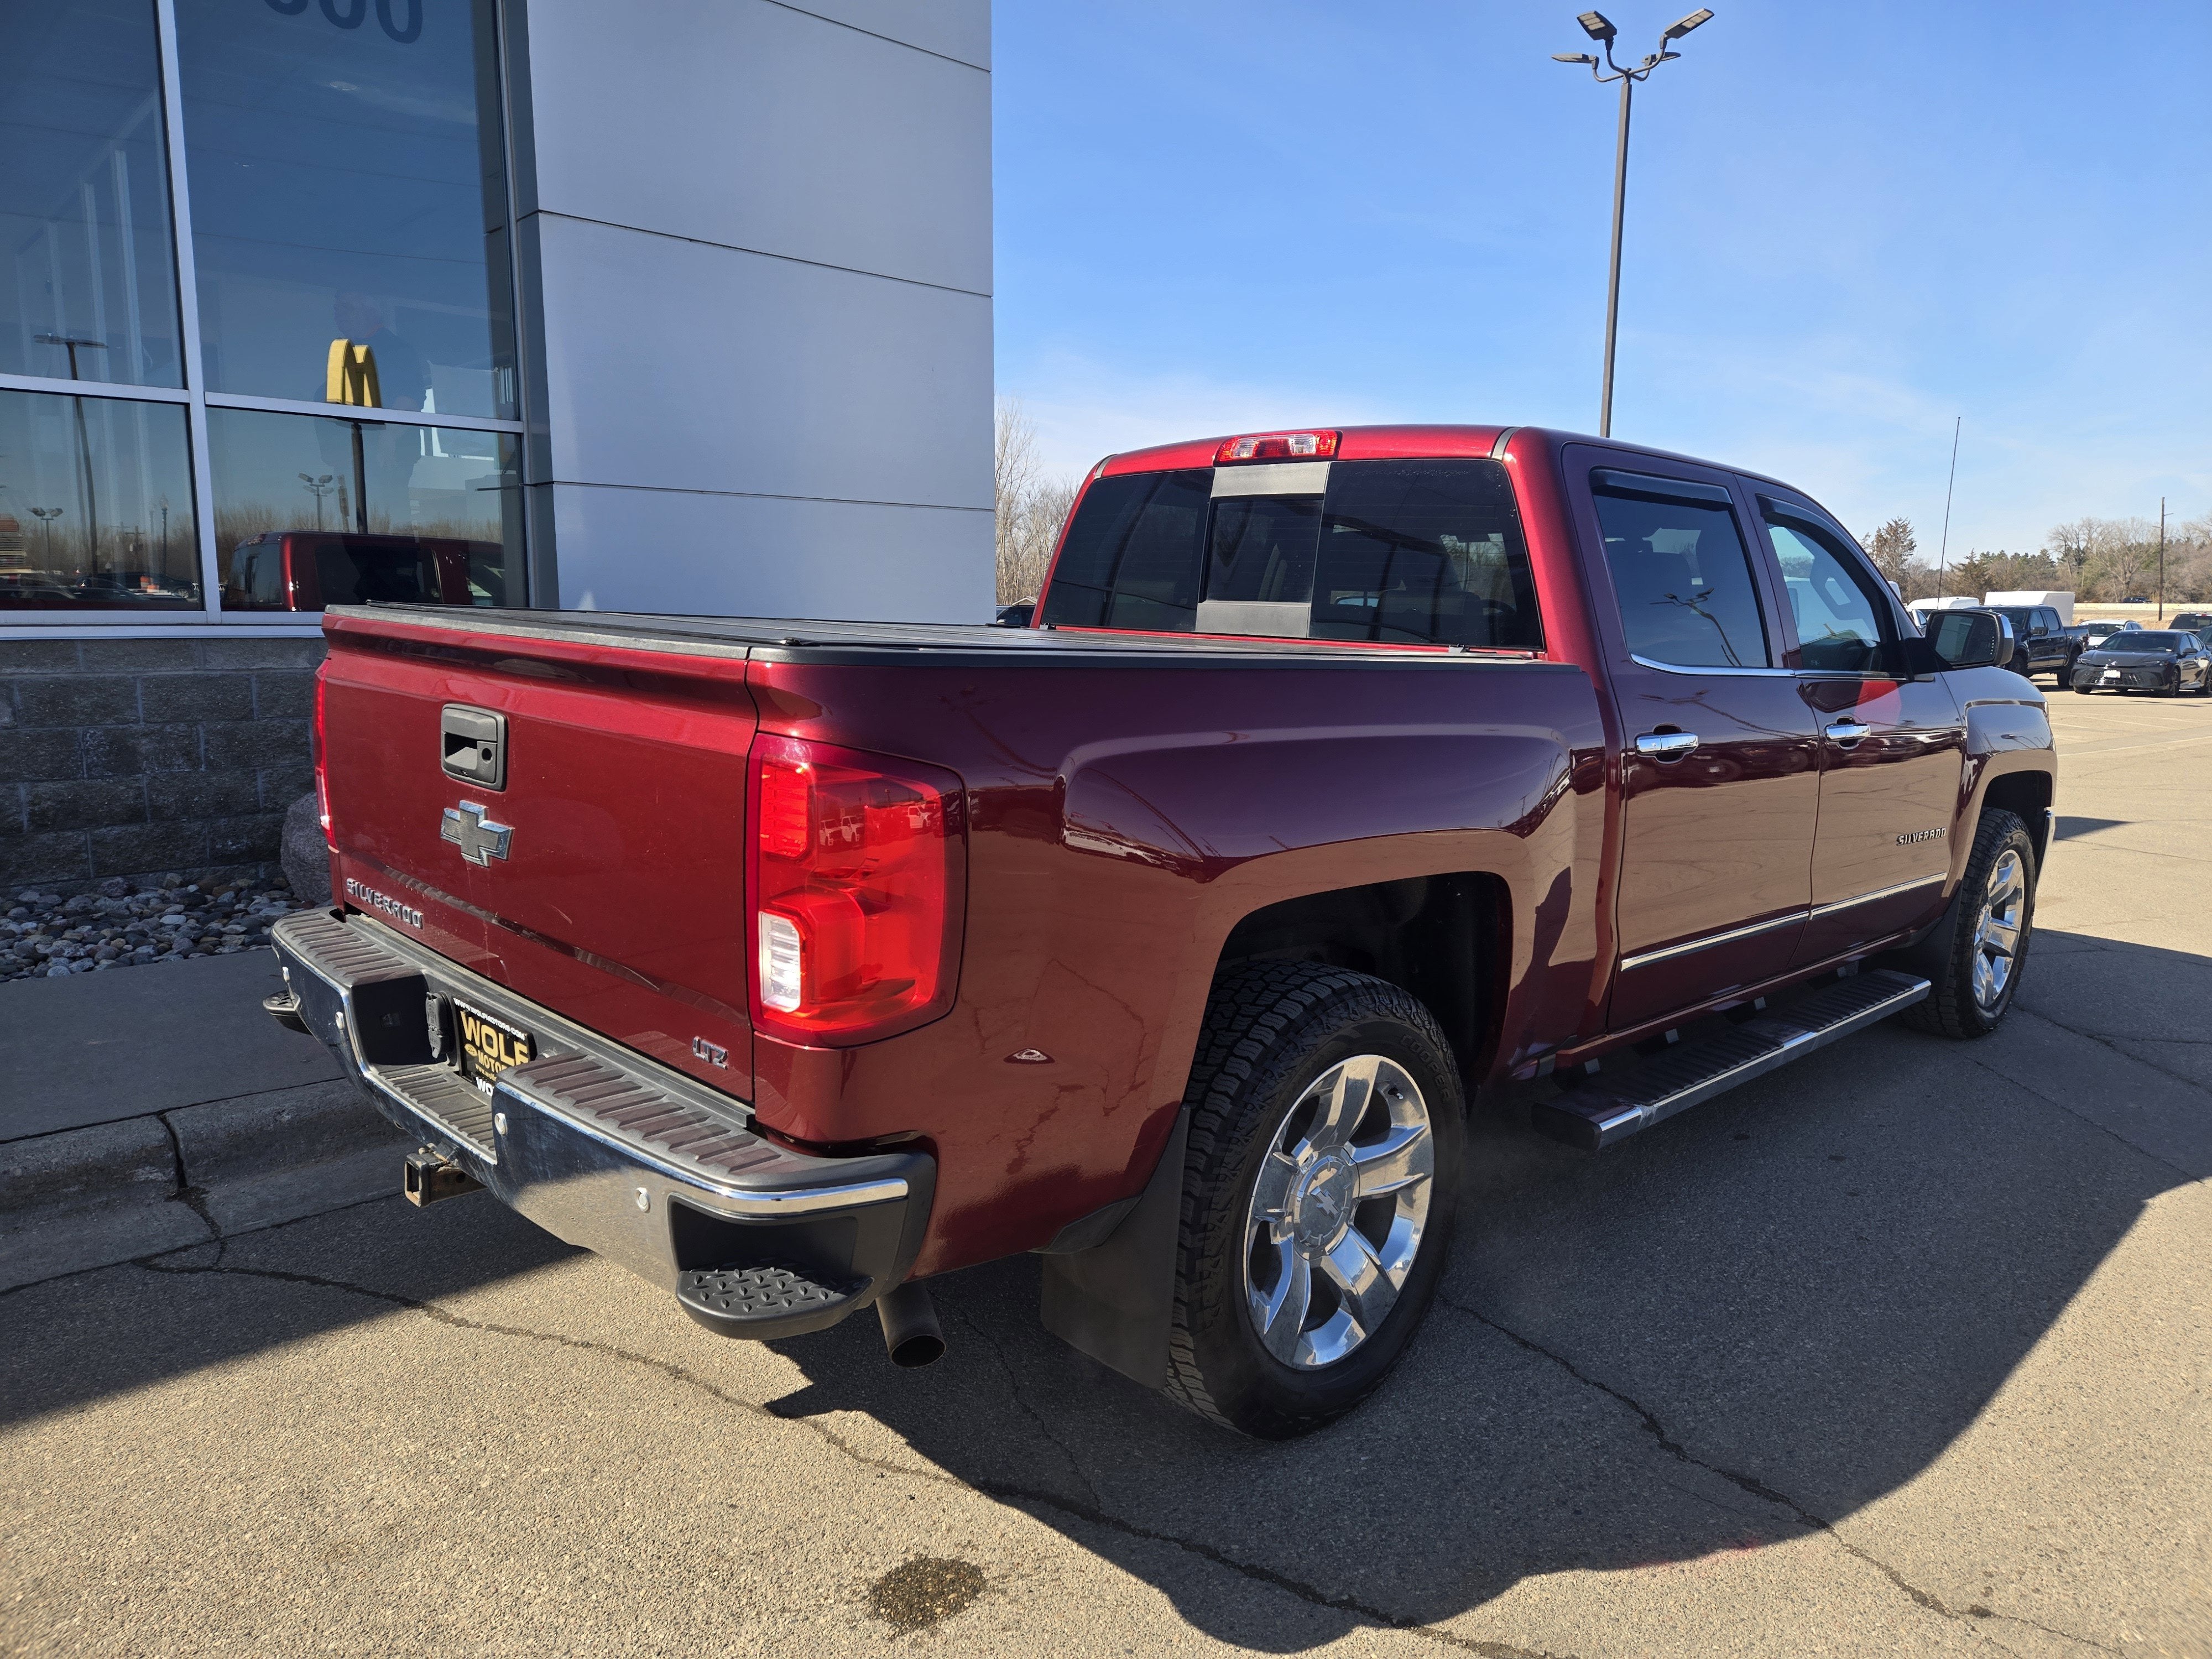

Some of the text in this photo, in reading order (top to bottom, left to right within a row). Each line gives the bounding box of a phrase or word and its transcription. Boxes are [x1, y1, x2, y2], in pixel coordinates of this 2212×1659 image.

[1896, 827, 1947, 846] SILVERADO
[346, 878, 424, 929] SILVERADO
[461, 1011, 529, 1066] WOLF
[692, 1036, 728, 1070] LTZ
[476, 1077, 494, 1097] WO
[1400, 1034, 1451, 1098] COOPER
